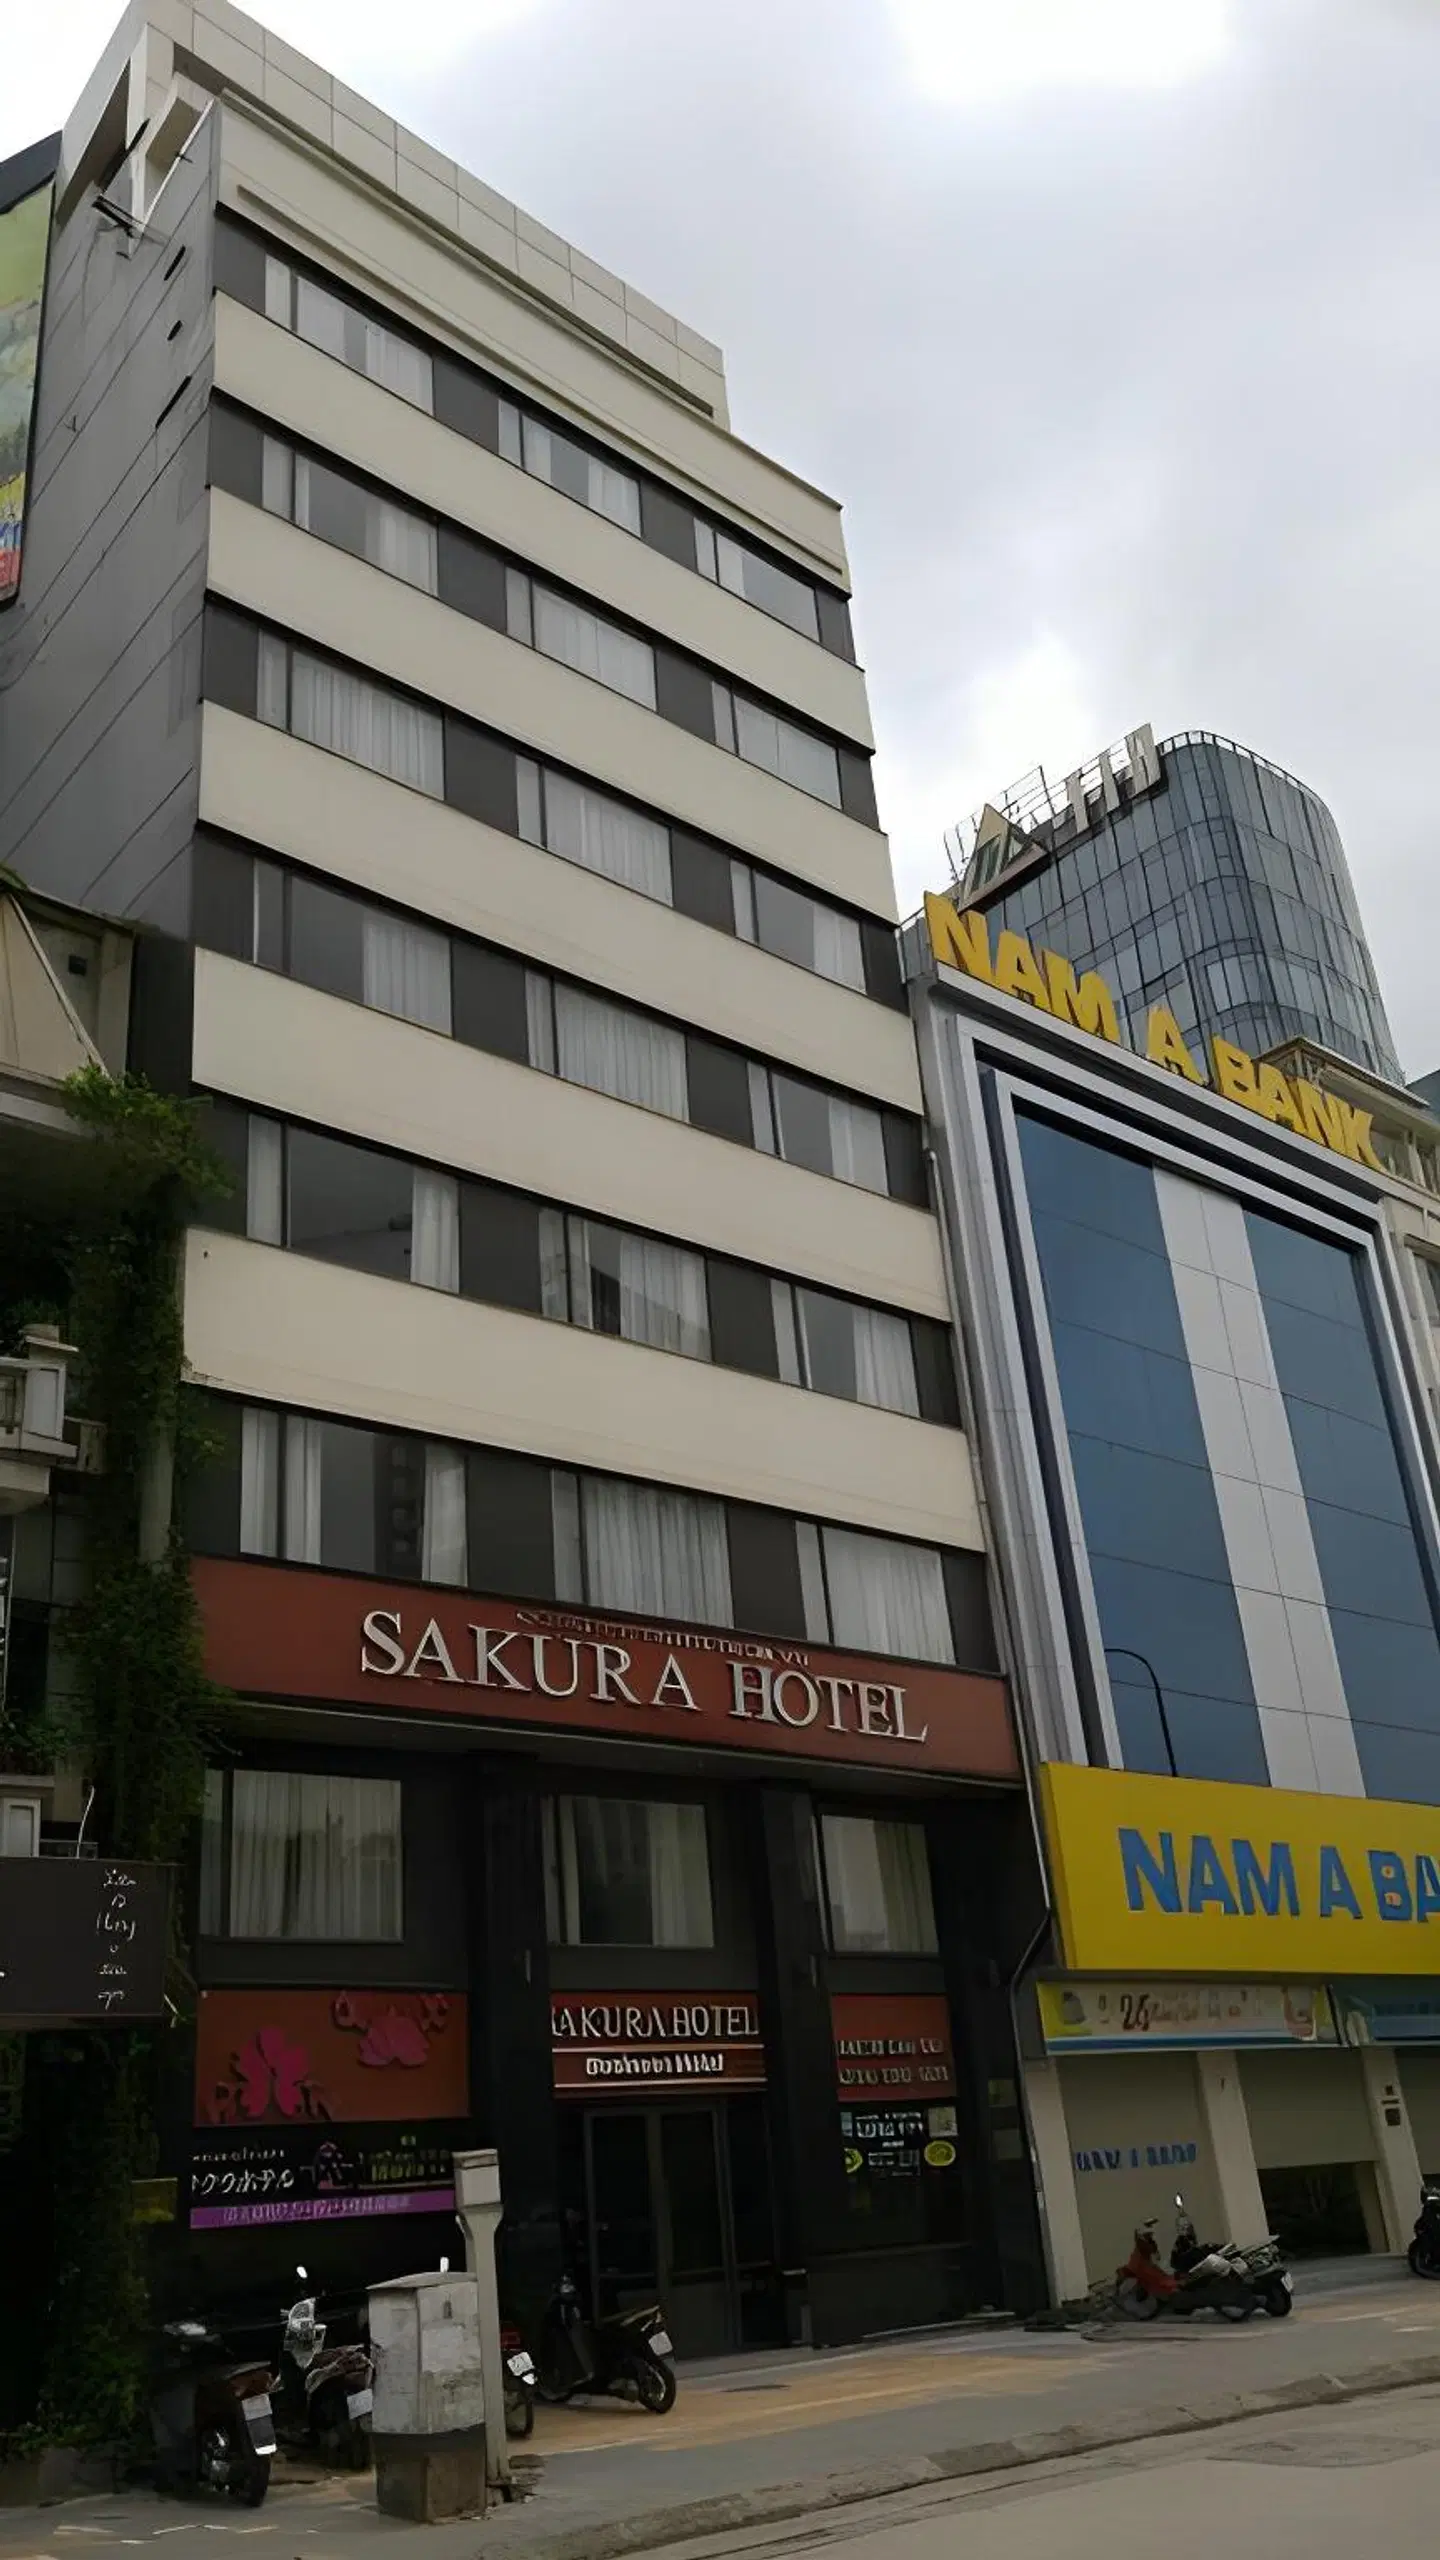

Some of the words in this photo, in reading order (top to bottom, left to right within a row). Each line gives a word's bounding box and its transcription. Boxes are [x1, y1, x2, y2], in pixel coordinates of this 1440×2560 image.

[923, 890, 1122, 1046] NAM
[1146, 1005, 1206, 1086] A
[1211, 1033, 1388, 1173] BANK
[361, 1610, 703, 1712] SAKURA
[725, 1659, 929, 1743] HOTEL
[1117, 1826, 1301, 1916] NAM
[1319, 1845, 1363, 1920] A
[669, 2004, 760, 2037] HOTEL
